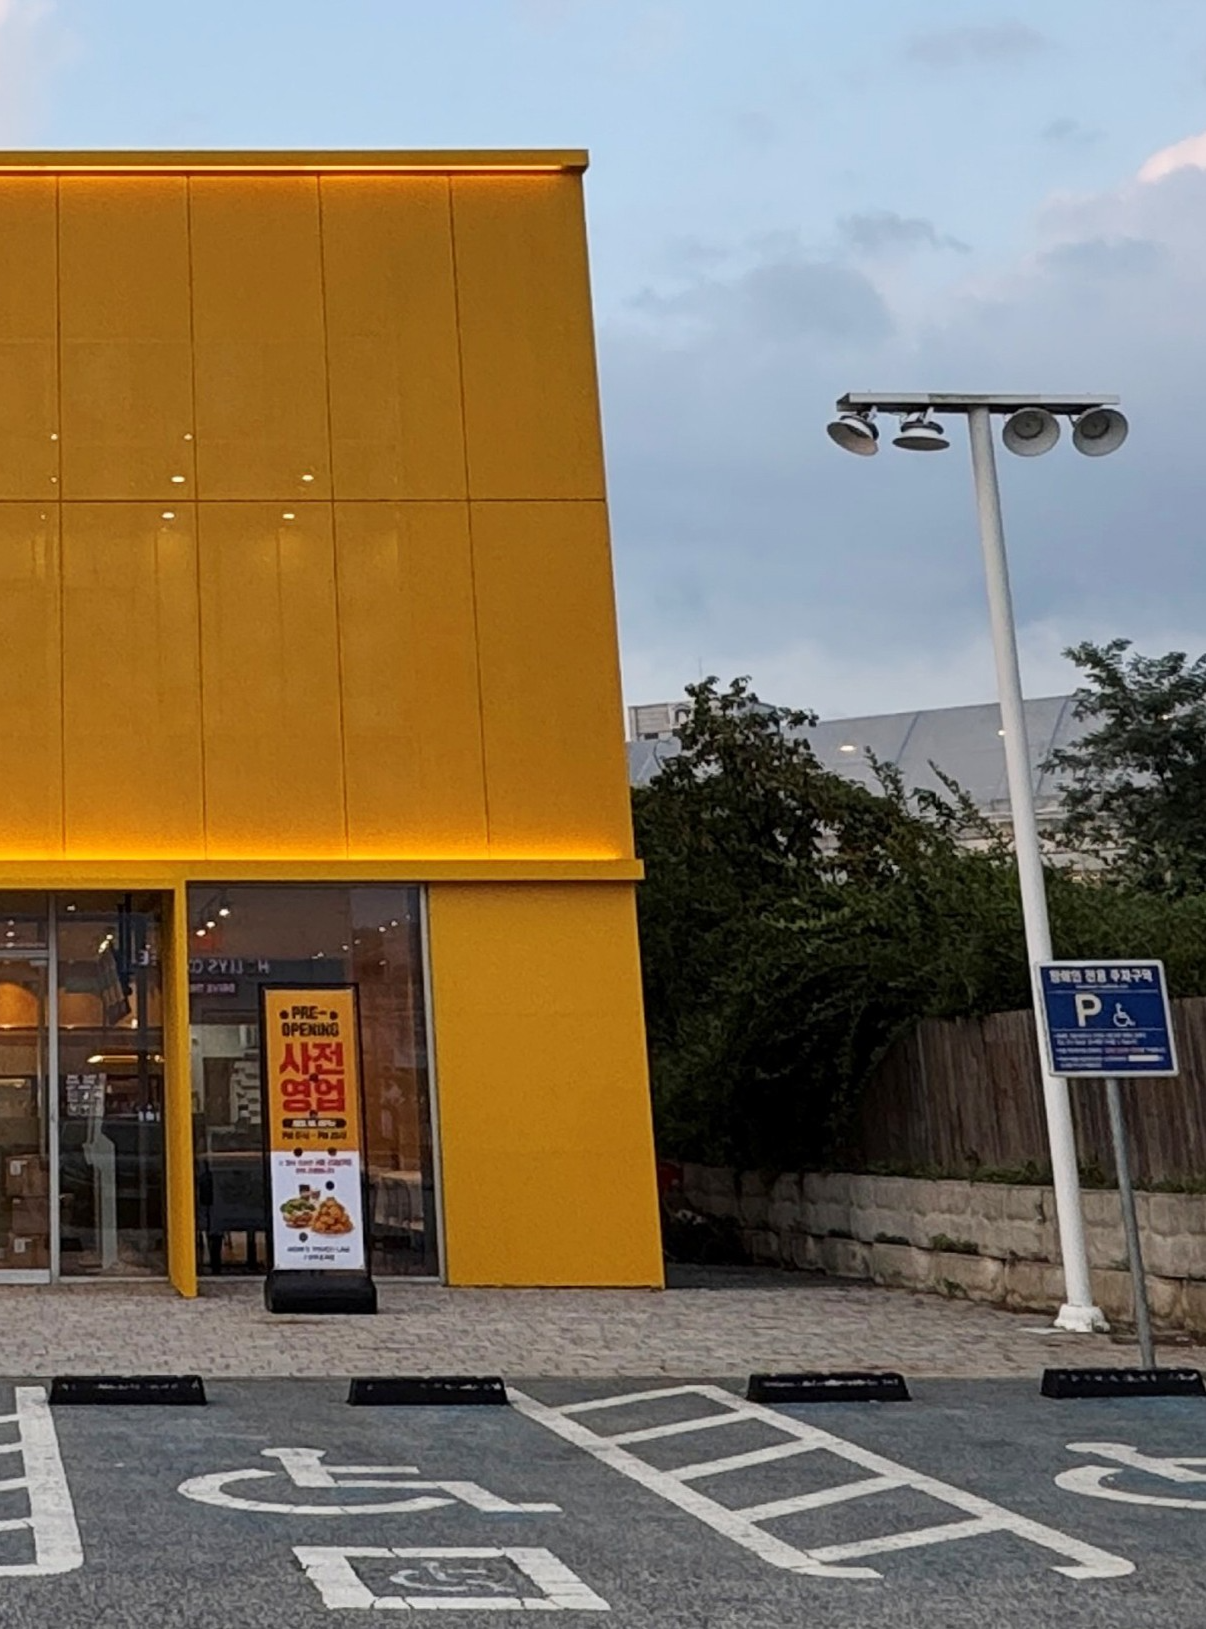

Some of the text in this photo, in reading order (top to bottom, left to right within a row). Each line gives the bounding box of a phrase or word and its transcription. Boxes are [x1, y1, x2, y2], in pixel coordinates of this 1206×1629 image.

[291, 1006, 328, 1020] PRE-
[1075, 993, 1102, 1027] P
[281, 1022, 339, 1037] OPENING
[279, 1041, 345, 1075] 사전
[280, 1077, 347, 1113] 영업
